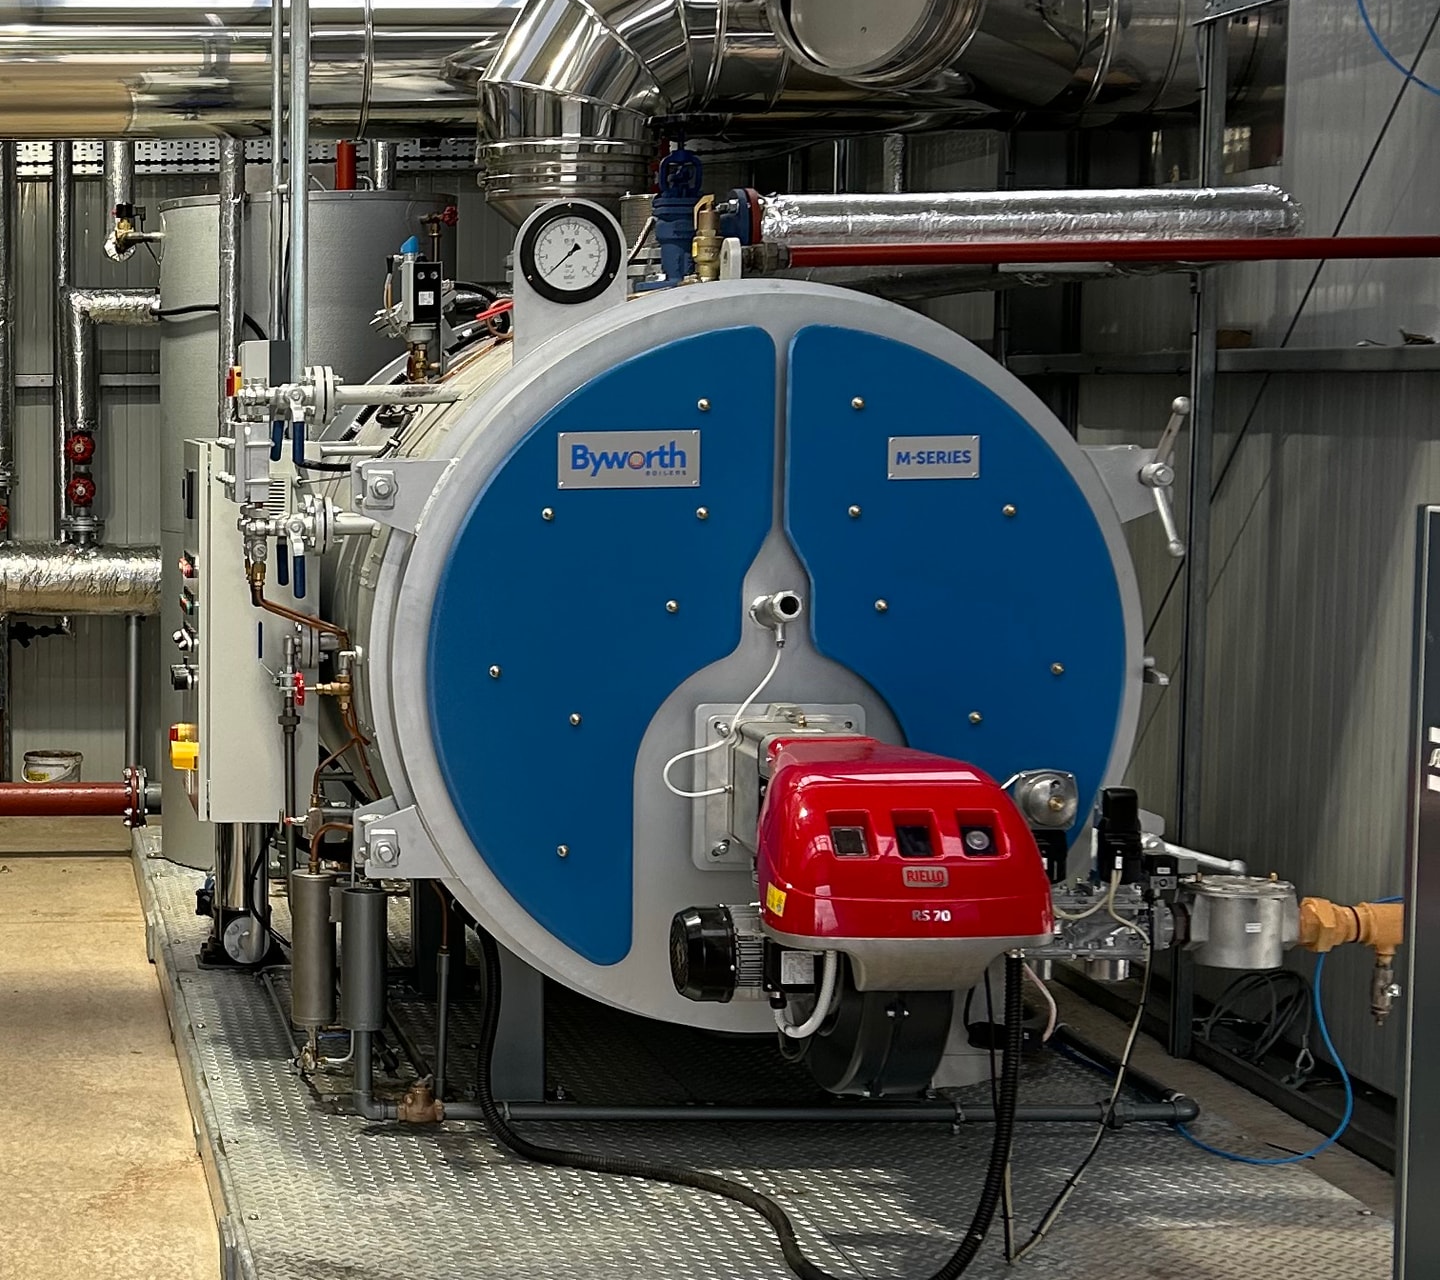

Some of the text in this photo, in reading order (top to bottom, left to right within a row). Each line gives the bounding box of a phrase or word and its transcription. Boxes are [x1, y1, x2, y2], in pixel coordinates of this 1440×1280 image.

[571, 440, 687, 477] Byworth
[896, 450, 972, 465] M-SERIES
[906, 869, 946, 883] RIELLO
[912, 910, 951, 922] RS 70
